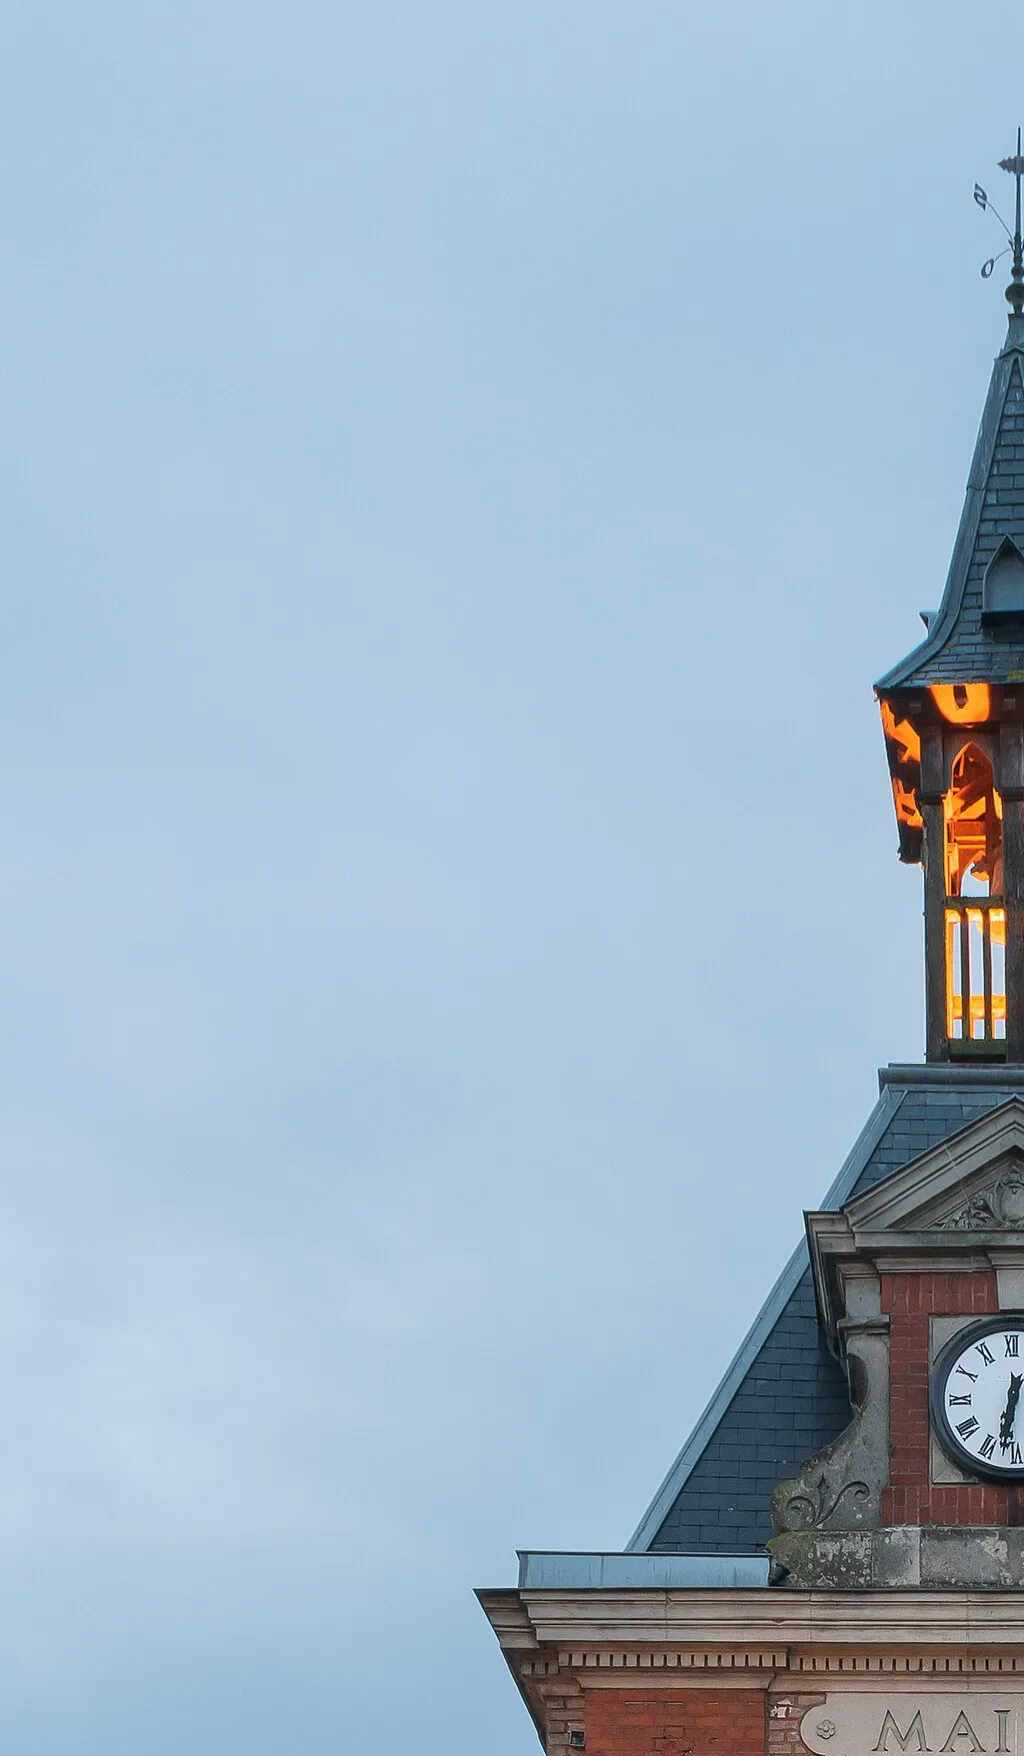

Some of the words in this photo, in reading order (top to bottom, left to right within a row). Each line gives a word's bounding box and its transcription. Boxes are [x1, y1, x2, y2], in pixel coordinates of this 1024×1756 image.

[981, 258, 994, 278] O
[974, 1341, 996, 1367] XI
[1004, 1334, 1019, 1357] XII
[955, 1364, 979, 1383] X
[949, 1394, 971, 1406] IX
[955, 1414, 981, 1442] VIII
[977, 1433, 998, 1460] VII
[1010, 1441, 1023, 1464] VI
